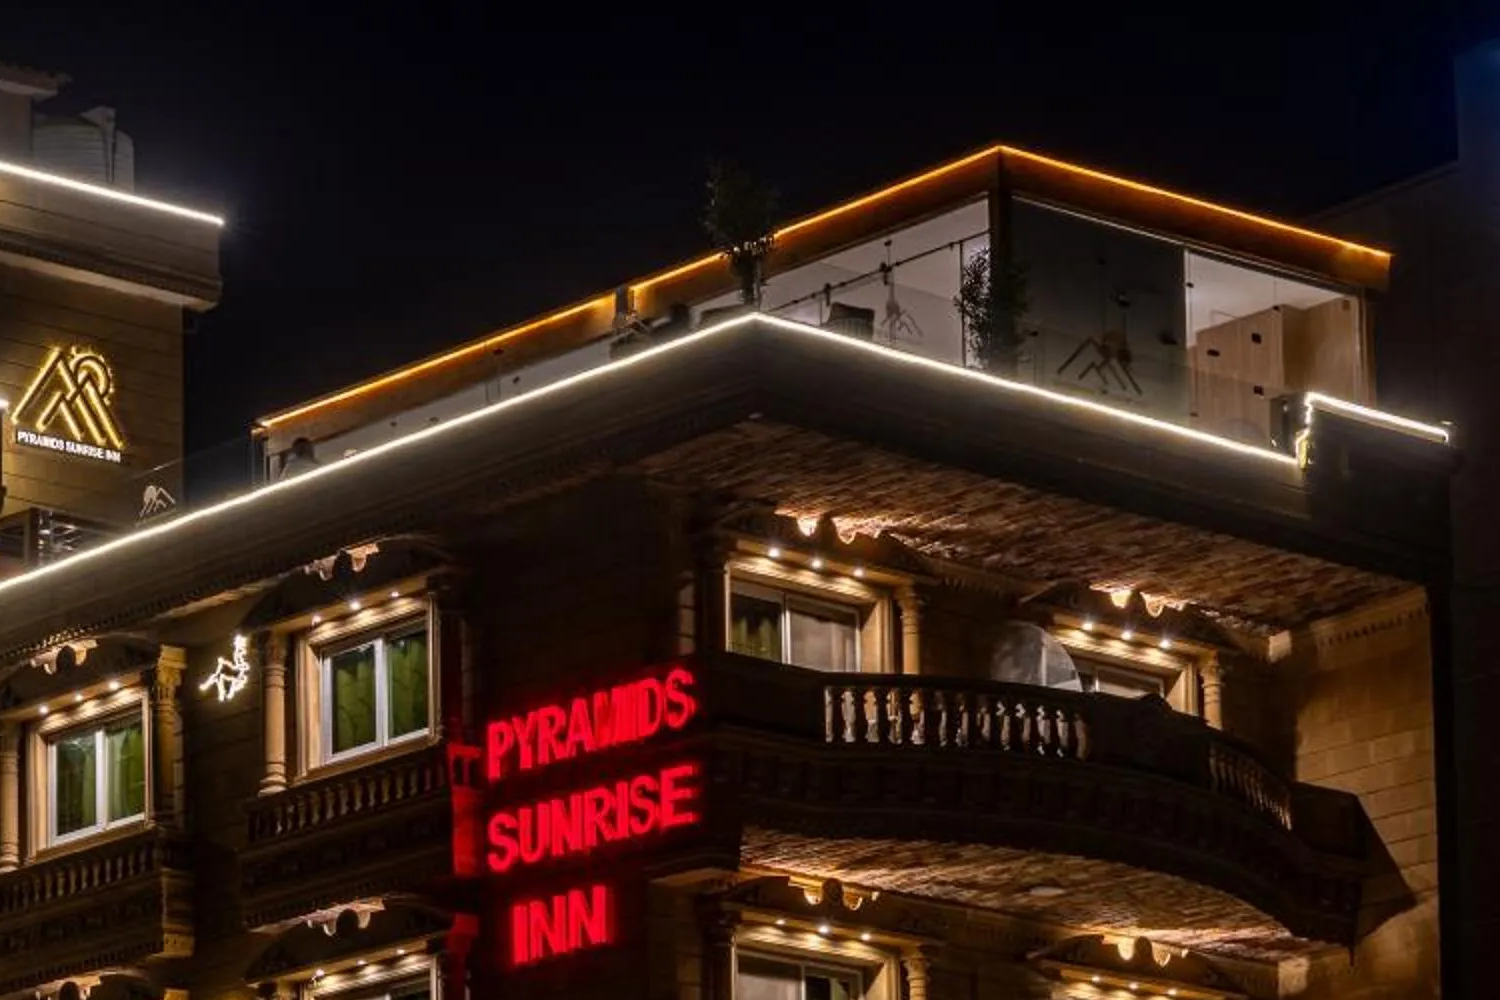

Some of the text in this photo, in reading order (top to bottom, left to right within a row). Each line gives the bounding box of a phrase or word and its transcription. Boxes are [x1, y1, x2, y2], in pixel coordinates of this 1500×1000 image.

[488, 668, 696, 780] PYRAMIDS
[487, 765, 697, 872] SUNRISE
[512, 885, 609, 964] INN
